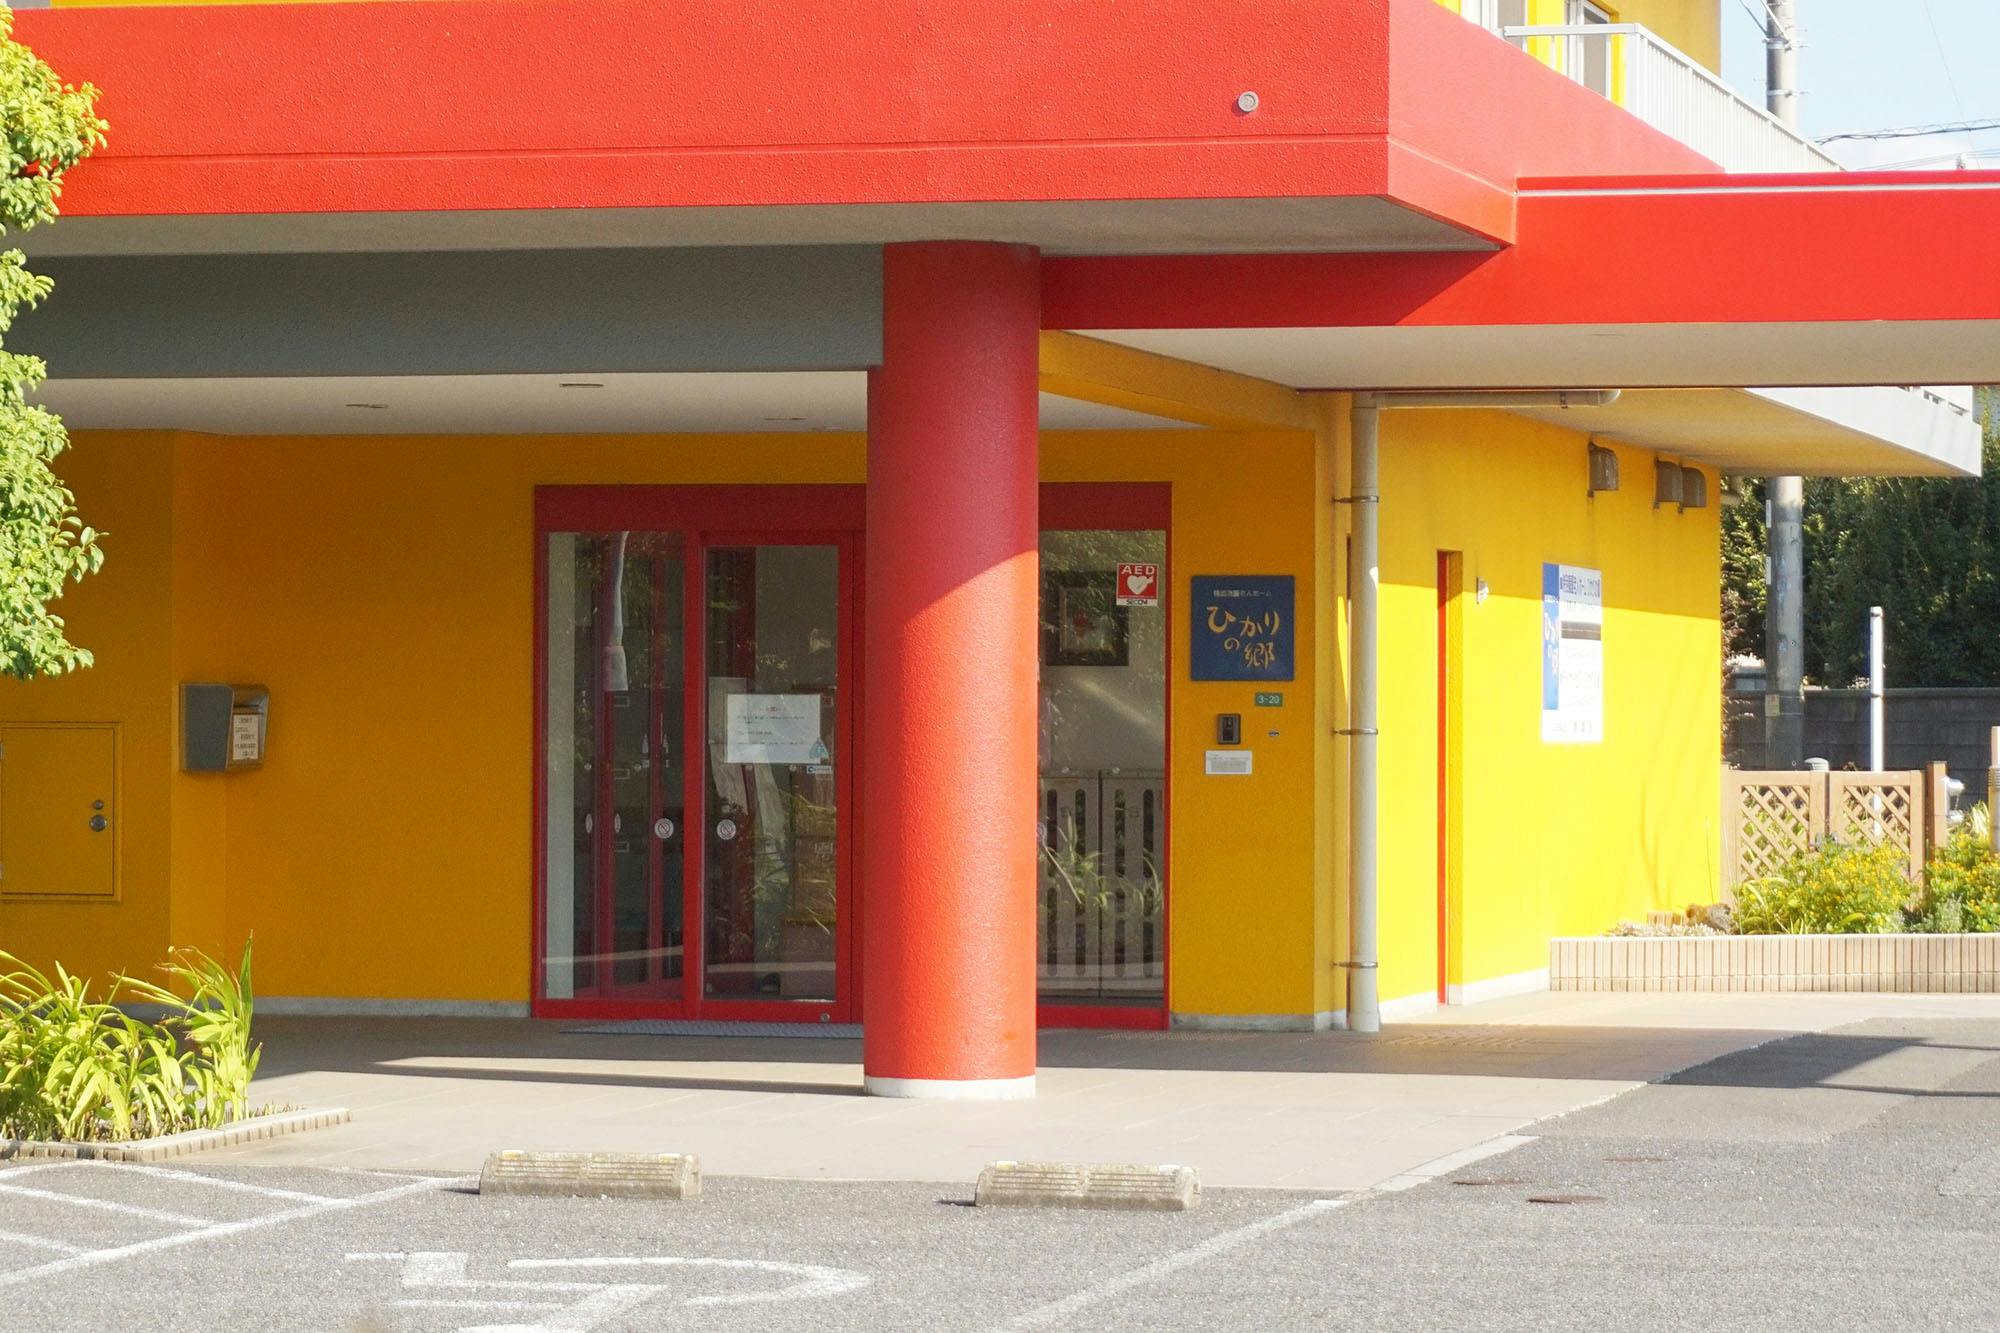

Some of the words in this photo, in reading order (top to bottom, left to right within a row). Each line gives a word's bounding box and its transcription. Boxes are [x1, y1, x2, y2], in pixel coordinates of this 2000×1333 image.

[1121, 565, 1155, 575] AED
[1213, 589, 1272, 598] 老人ホーム
[1206, 605, 1281, 638] ひかり
[1223, 637, 1276, 670] の郷
[1258, 695, 1280, 704] 3-20
